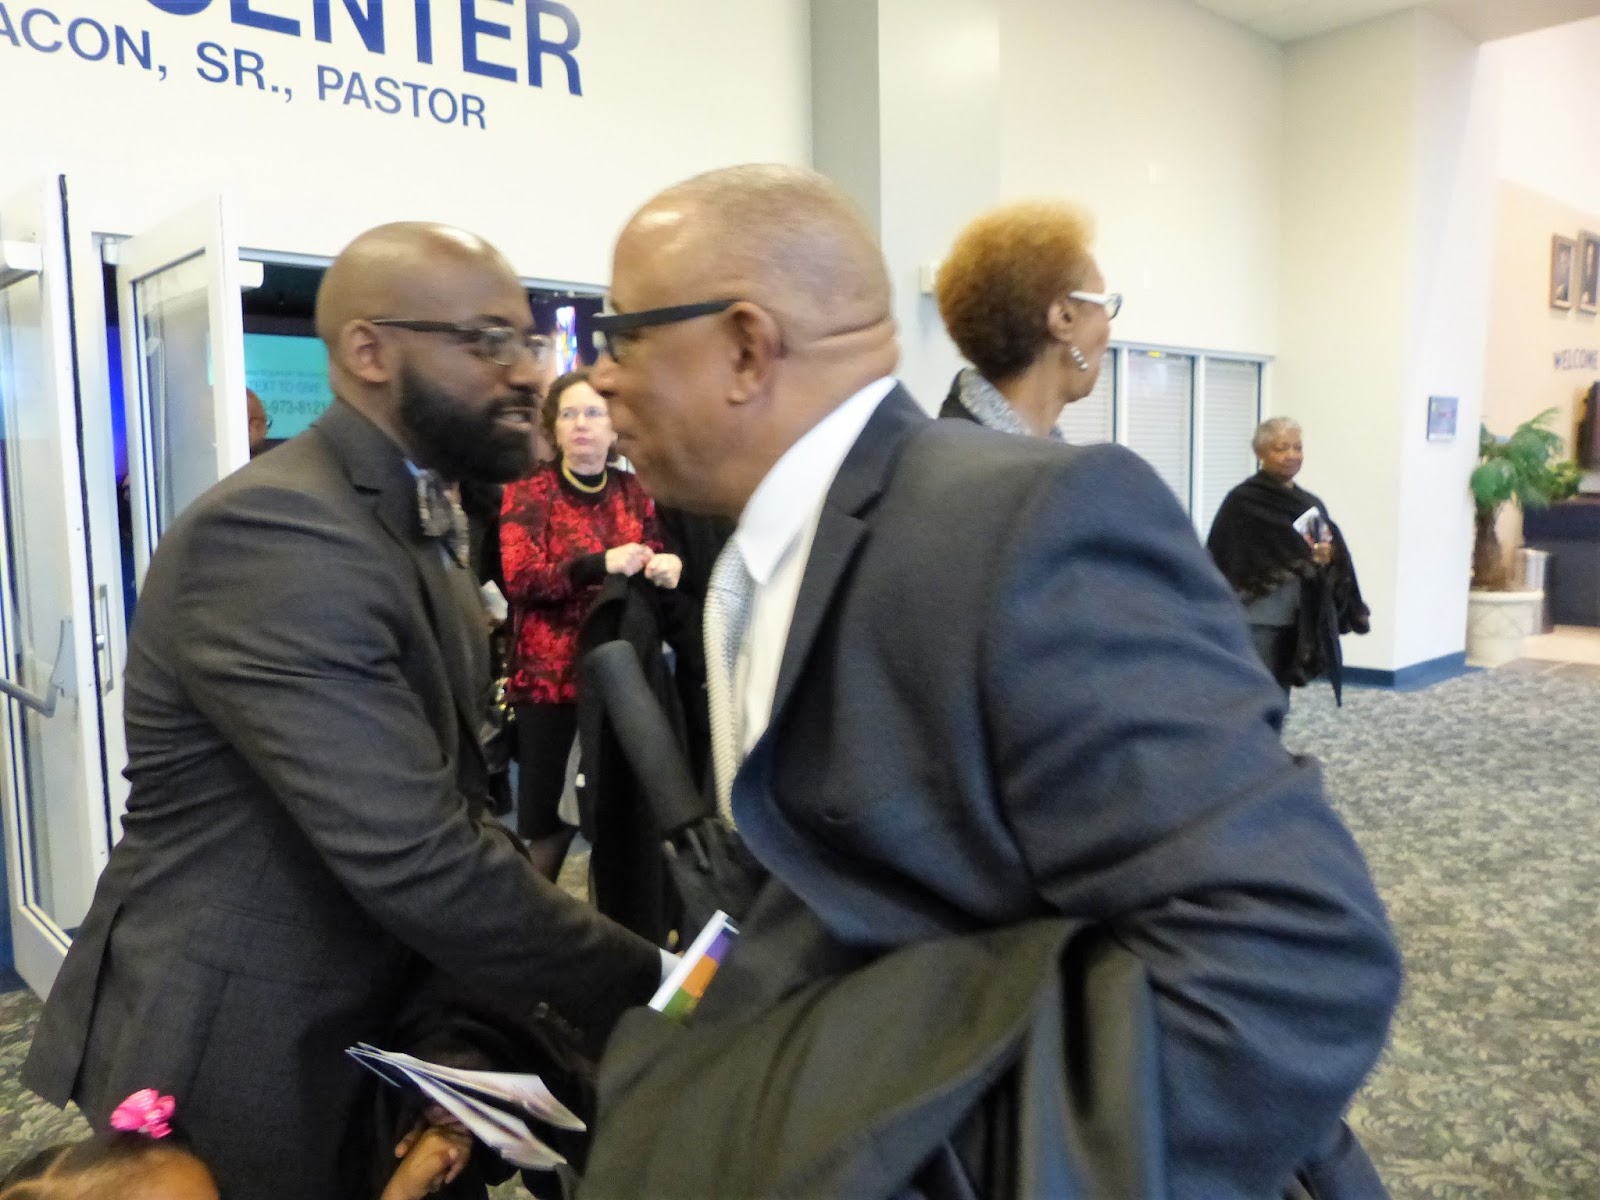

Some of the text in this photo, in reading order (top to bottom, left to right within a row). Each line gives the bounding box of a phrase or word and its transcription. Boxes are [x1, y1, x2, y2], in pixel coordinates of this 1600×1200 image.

[147, 0, 583, 97] NTER
[196, 40, 292, 103] SR.,
[317, 64, 486, 129] PASTOR
